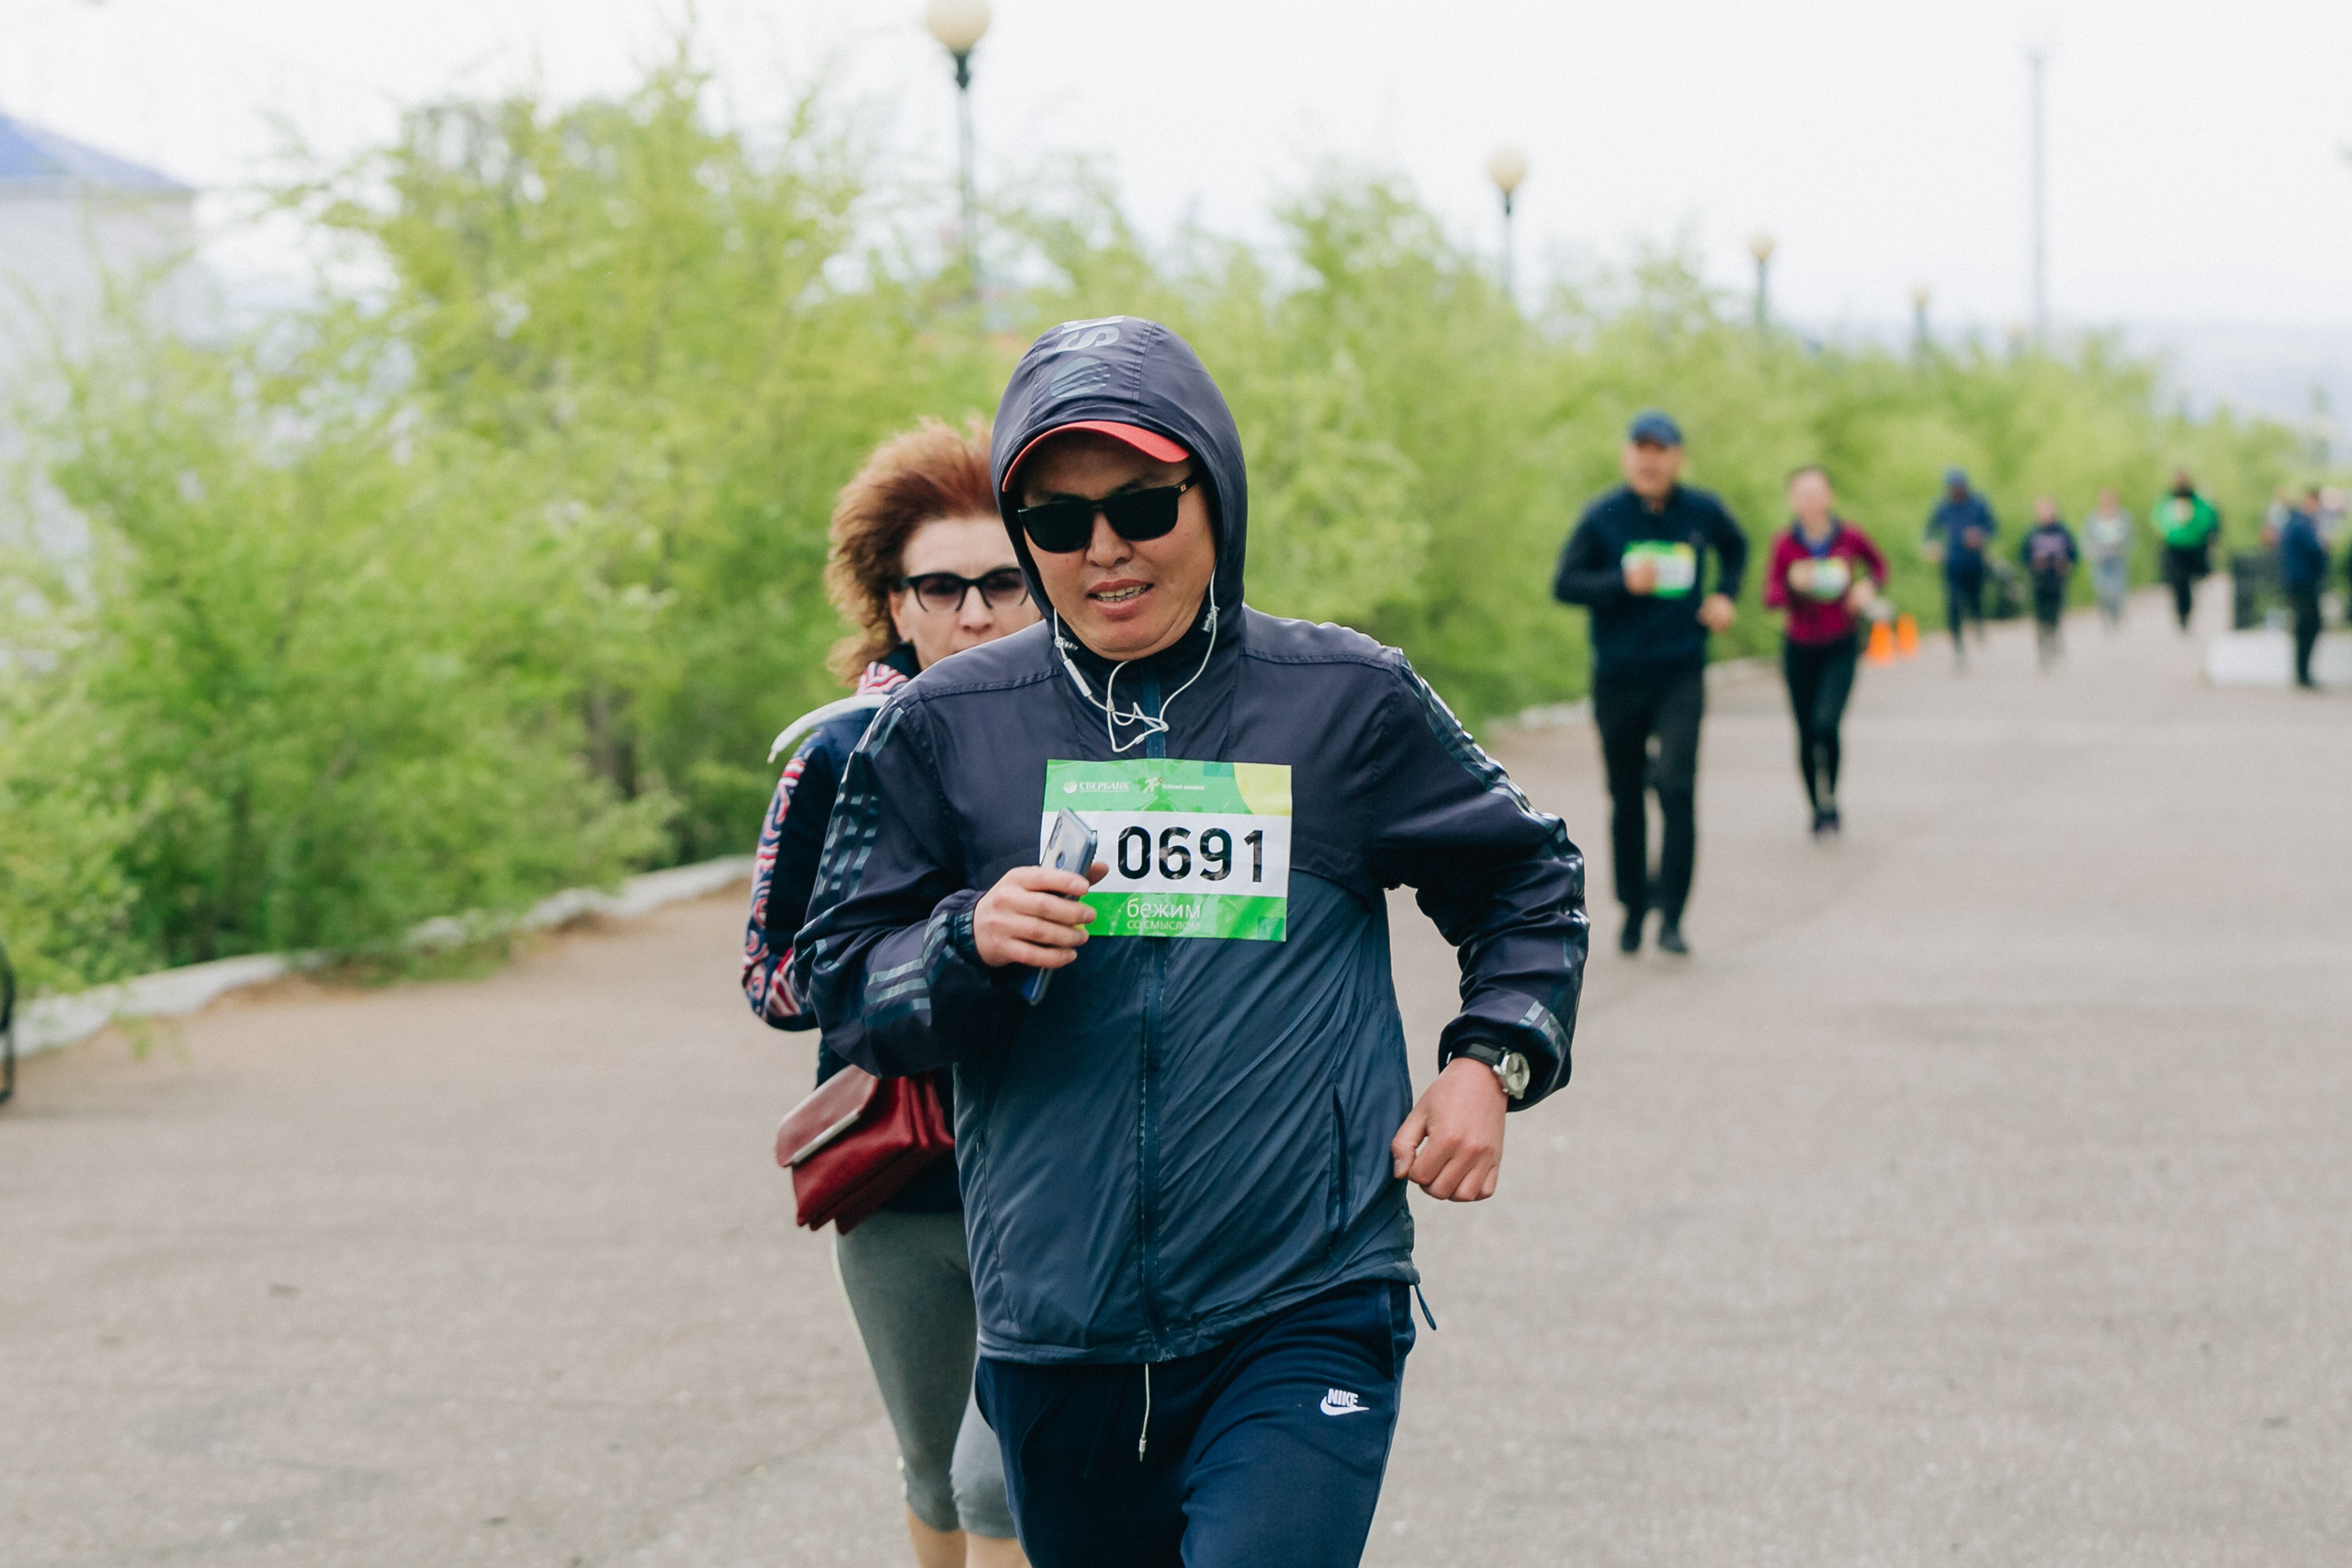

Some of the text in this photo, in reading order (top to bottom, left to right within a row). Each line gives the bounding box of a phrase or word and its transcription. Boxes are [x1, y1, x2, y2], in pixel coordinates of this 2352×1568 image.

[1117, 826, 1264, 883] 0691
[1126, 897, 1201, 919] бежим
[1327, 1388, 1359, 1407] NIKE
